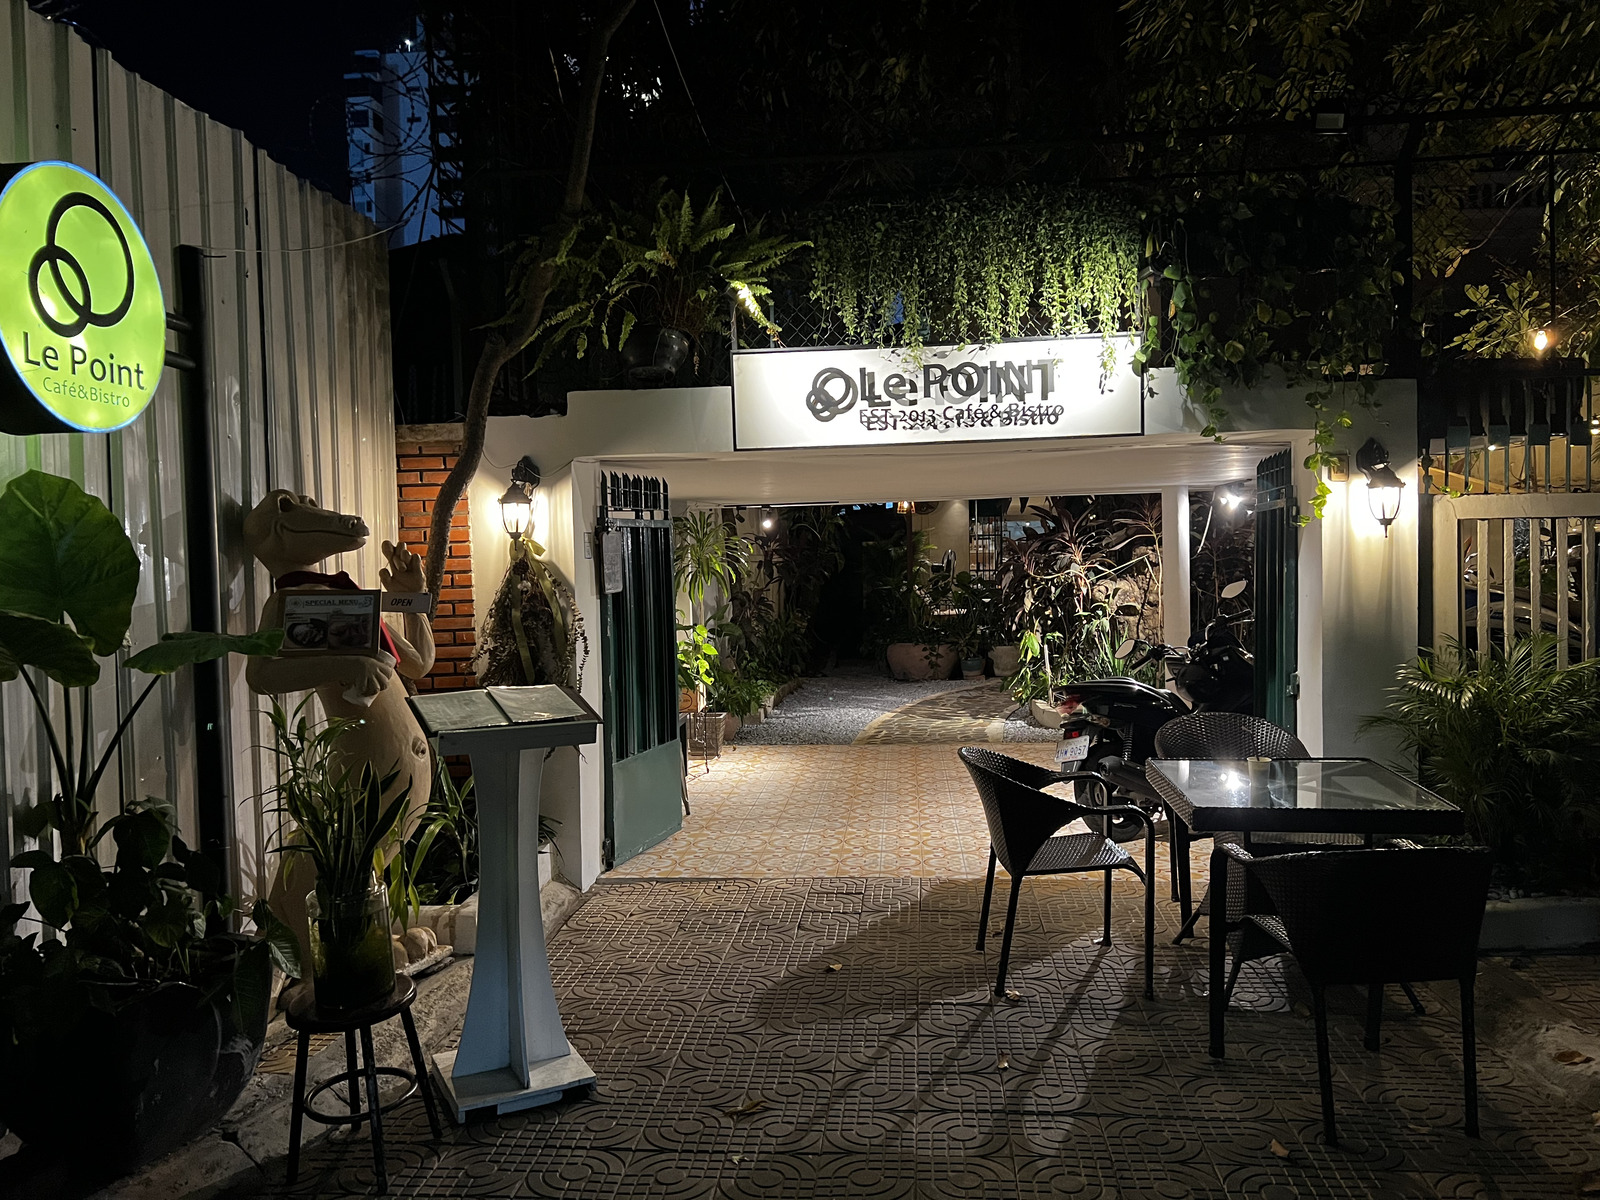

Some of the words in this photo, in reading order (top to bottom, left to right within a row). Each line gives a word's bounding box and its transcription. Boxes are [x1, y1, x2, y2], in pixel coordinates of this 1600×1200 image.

[22, 331, 59, 371] Le
[70, 344, 146, 391] Point
[859, 366, 908, 402] Le
[922, 359, 1056, 401] POINT
[42, 376, 130, 408] Café&Bistro
[942, 403, 984, 420] Café
[1008, 402, 1065, 418] Bistro
[304, 599, 337, 607] SPECIAL
[390, 598, 413, 607] OPEN
[1069, 744, 1087, 756] 9057
